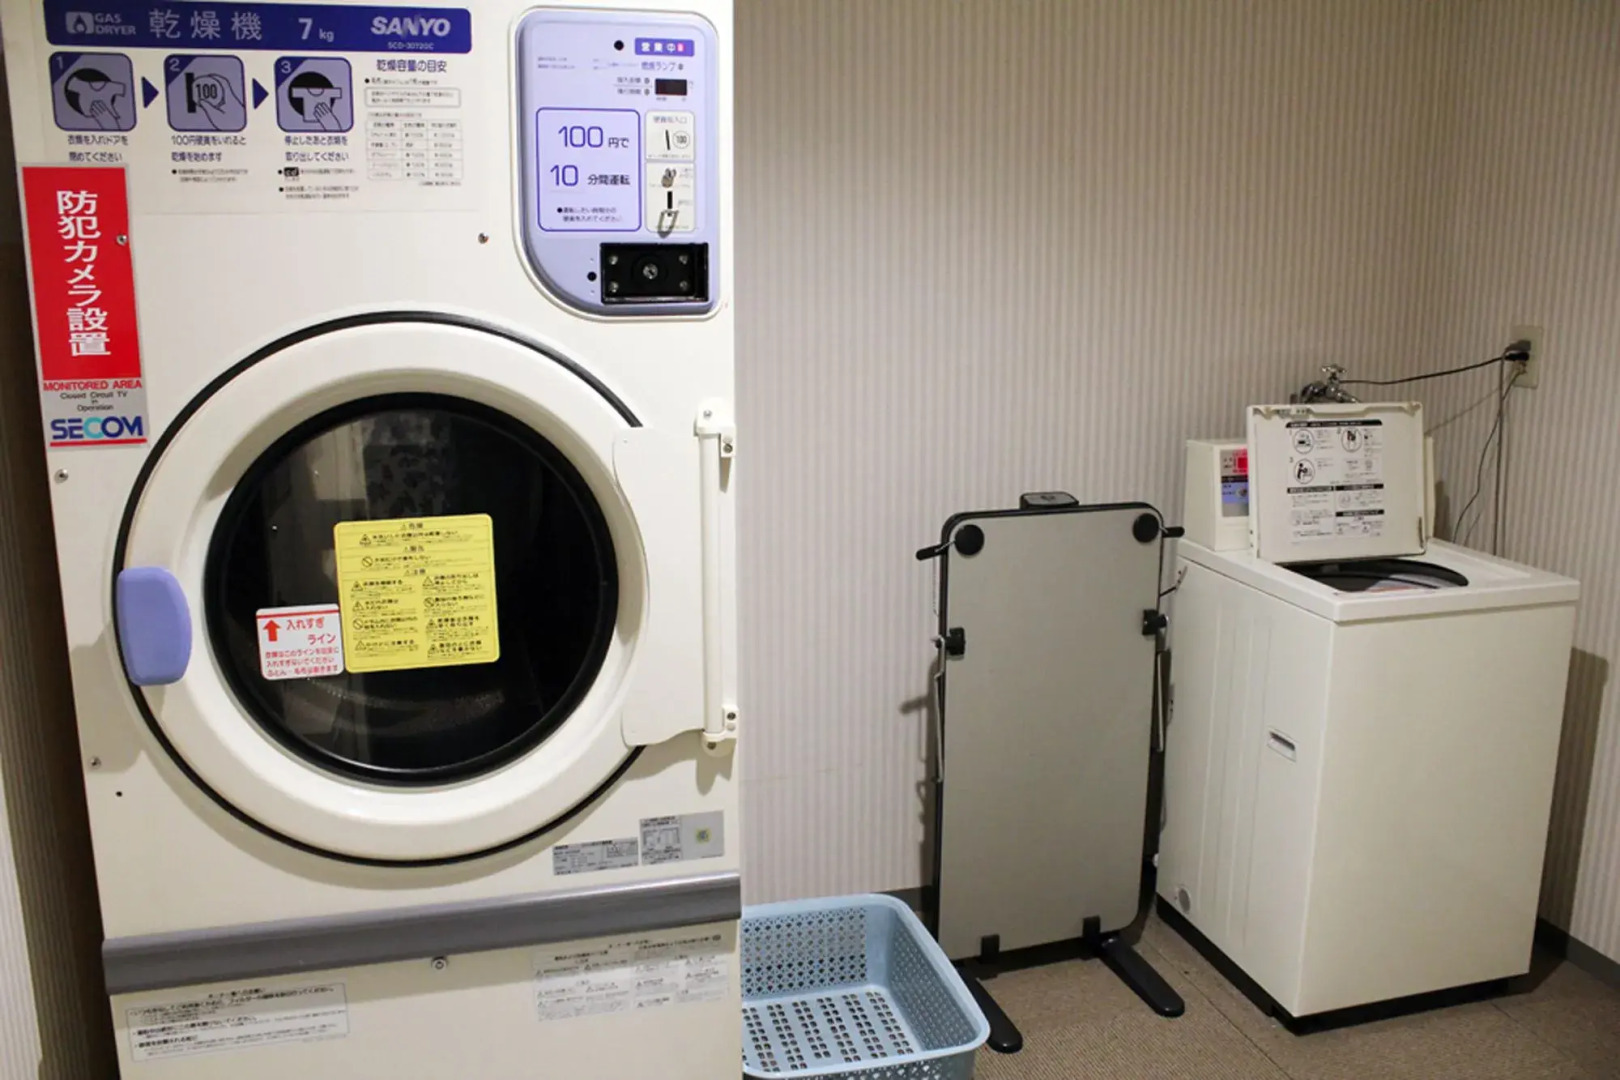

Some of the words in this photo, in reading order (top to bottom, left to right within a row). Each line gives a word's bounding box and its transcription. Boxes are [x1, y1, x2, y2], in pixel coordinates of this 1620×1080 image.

[94, 13, 122, 24] GAS
[94, 25, 136, 35] DRYER
[149, 9, 263, 40] 乾燥機
[298, 18, 313, 40] 7
[318, 28, 335, 43] kg
[371, 16, 451, 37] SANYO
[56, 57, 64, 69] 1
[169, 60, 180, 72] 2
[281, 62, 291, 73] 3
[376, 59, 447, 73] 乾燥容量の目安
[196, 83, 217, 99] 100
[558, 126, 603, 148] 100
[608, 137, 629, 149] 円で
[550, 165, 579, 186] 10
[587, 174, 631, 186] 分間運転
[56, 190, 111, 357] 防犯カメラ設置
[43, 381, 108, 391] MONITORED
[113, 380, 142, 389] AREA
[50, 416, 143, 440] SECOM
[286, 617, 324, 630] 入れすぎ
[308, 633, 336, 645] ライン
